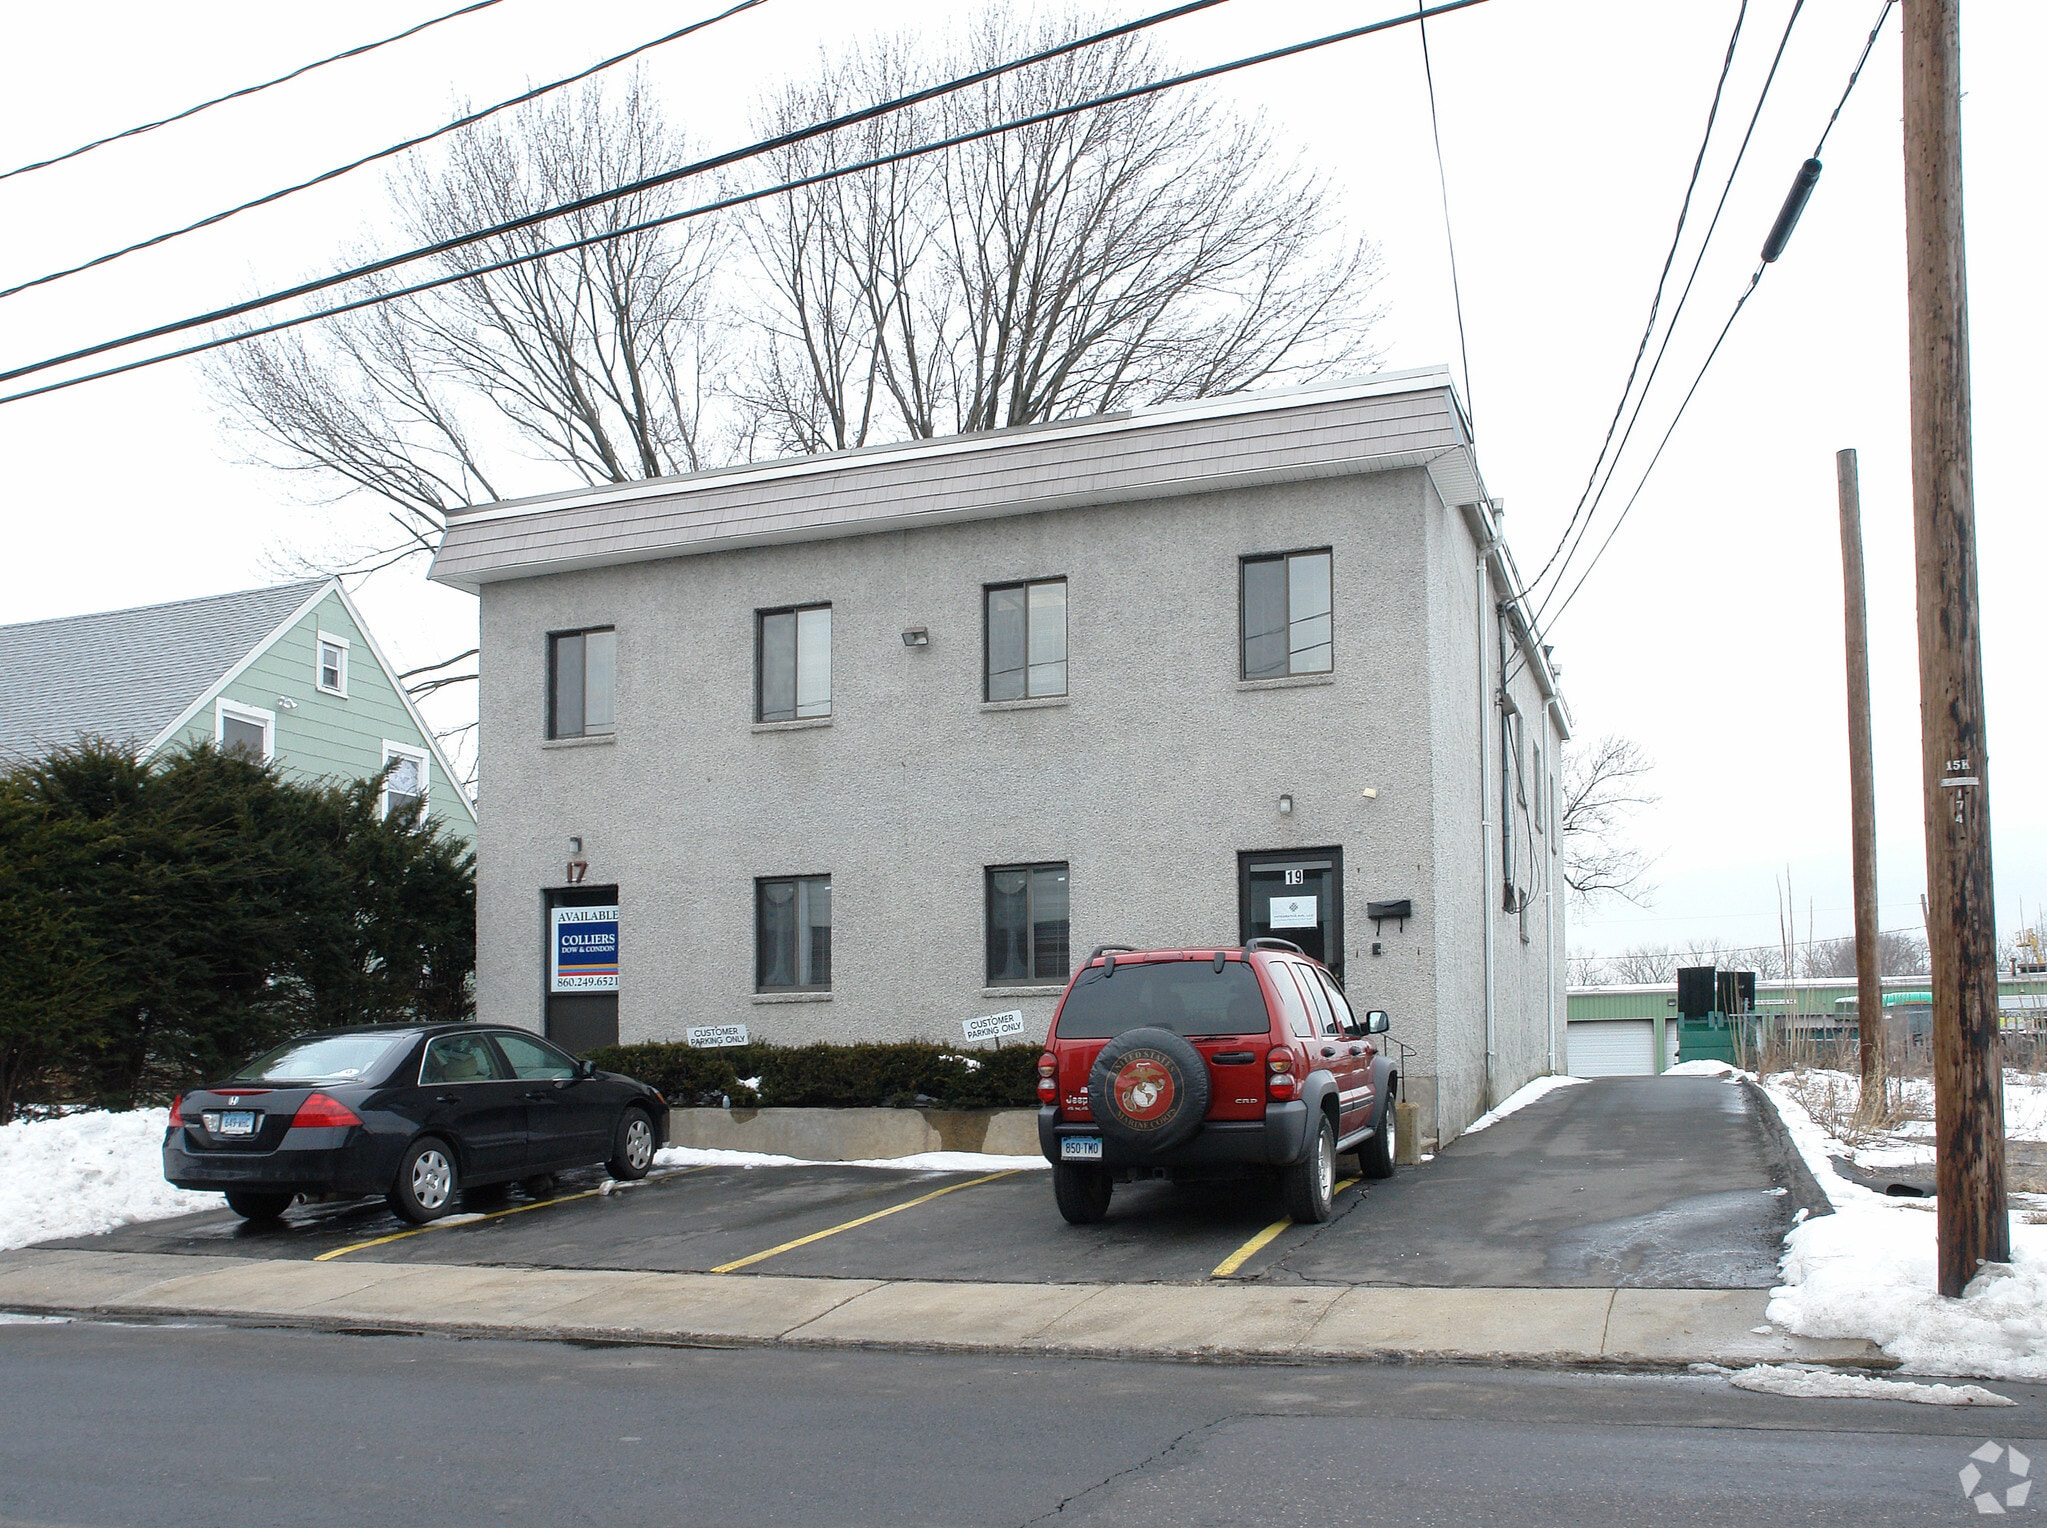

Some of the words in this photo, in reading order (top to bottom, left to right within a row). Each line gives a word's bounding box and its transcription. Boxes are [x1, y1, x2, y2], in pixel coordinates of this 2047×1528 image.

[1945, 759, 1971, 771] 15K
[567, 860, 588, 884] 17
[1287, 870, 1302, 884] 19
[558, 910, 618, 922] AVAILABLE
[561, 933, 616, 946] COLLIERS
[561, 946, 578, 954] DOW
[585, 944, 615, 953] CONDON
[557, 975, 619, 988] 860.249.6521
[970, 1014, 1014, 1029] CUSTOMER
[694, 1027, 739, 1038] CUSTOMER
[967, 1026, 999, 1038] PARKING
[1001, 1021, 1021, 1033] ONLY
[690, 1036, 724, 1046] PARKING
[725, 1035, 746, 1044] ONLY
[1065, 1094, 1089, 1106] Jeep
[1117, 1110, 1148, 1129] MARINE
